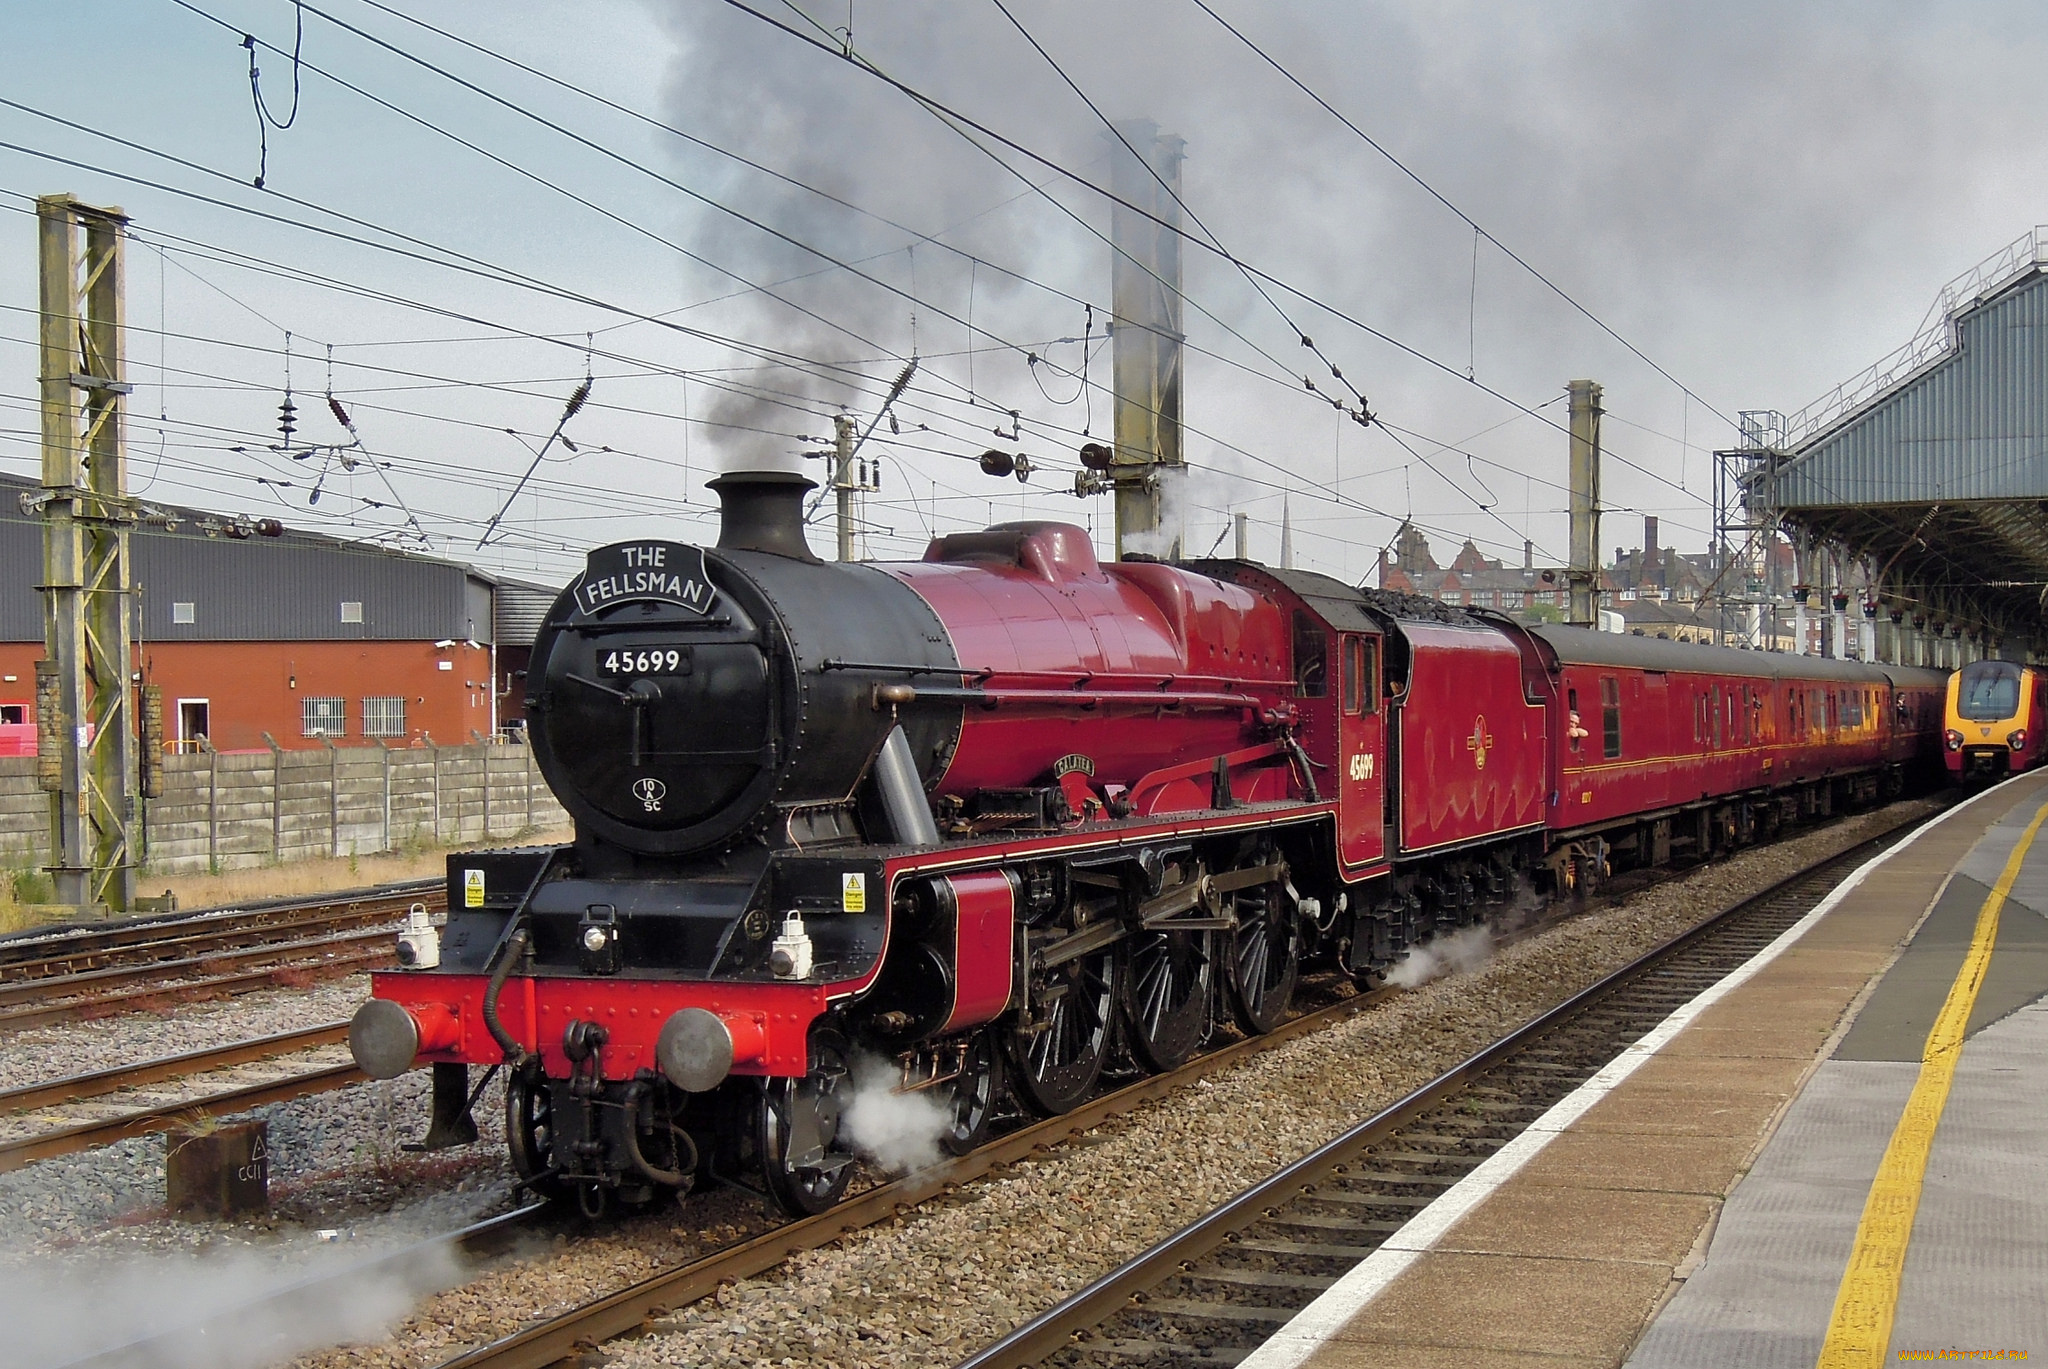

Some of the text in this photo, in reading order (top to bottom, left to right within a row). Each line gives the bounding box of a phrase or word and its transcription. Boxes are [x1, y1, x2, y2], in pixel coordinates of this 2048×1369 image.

[622, 547, 666, 567] THE
[586, 572, 703, 605] FELLSMAN
[605, 651, 680, 673] 45699
[1350, 753, 1374, 781] 45699
[643, 780, 655, 791] 10
[646, 790, 654, 800] A
[644, 801, 661, 812] SC
